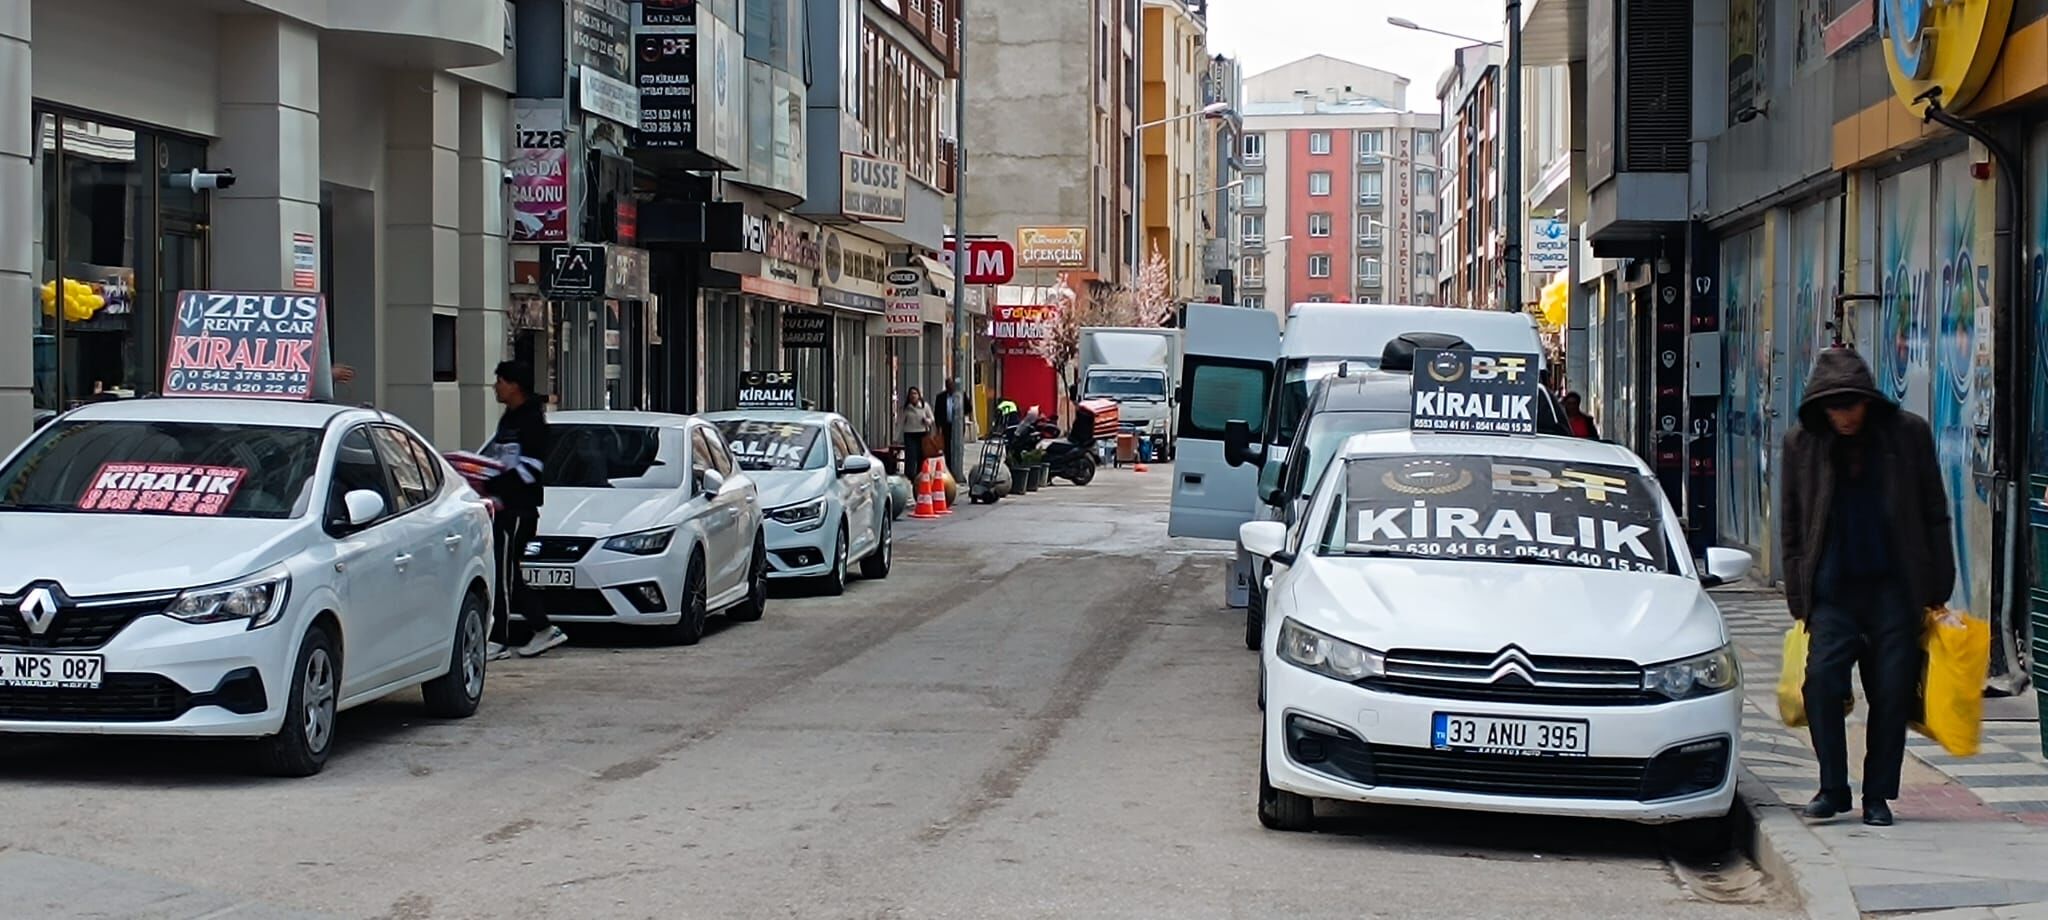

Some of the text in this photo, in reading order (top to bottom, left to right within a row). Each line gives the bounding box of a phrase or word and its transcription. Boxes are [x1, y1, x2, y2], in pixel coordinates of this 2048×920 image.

[851, 158, 898, 190] BUSSE
[512, 184, 563, 202] SALONU
[204, 293, 318, 321] ZEUS
[886, 314, 920, 324] VESTEL
[203, 318, 314, 334] RENT A CAR
[170, 330, 313, 373] KİRALIK
[188, 370, 307, 382] 0 542 378 35 41
[1470, 356, 1527, 381] BT
[186, 382, 307, 394] 0 543 420 22 65
[739, 386, 795, 401] KİRALIK
[1415, 386, 1533, 421] KİRALIK
[1414, 418, 1432, 428] 0553
[1433, 419, 1448, 429] 630
[1449, 420, 1458, 430] 41
[1460, 420, 1469, 430] 61
[1475, 420, 1494, 431] 0541
[1511, 422, 1521, 432] 15
[1521, 423, 1533, 433] 30
[1491, 463, 1629, 502] BT
[1357, 499, 1655, 561] KİRALIK
[1406, 543, 1441, 555] 630
[1446, 543, 1468, 555] 41
[1475, 543, 1497, 556] 61
[1566, 550, 1602, 567] 440
[548, 569, 572, 584] 173
[14, 656, 100, 680] NPS 087
[1449, 719, 1477, 744] 33
[1486, 722, 1527, 747] ANU
[1537, 724, 1578, 750] 395
